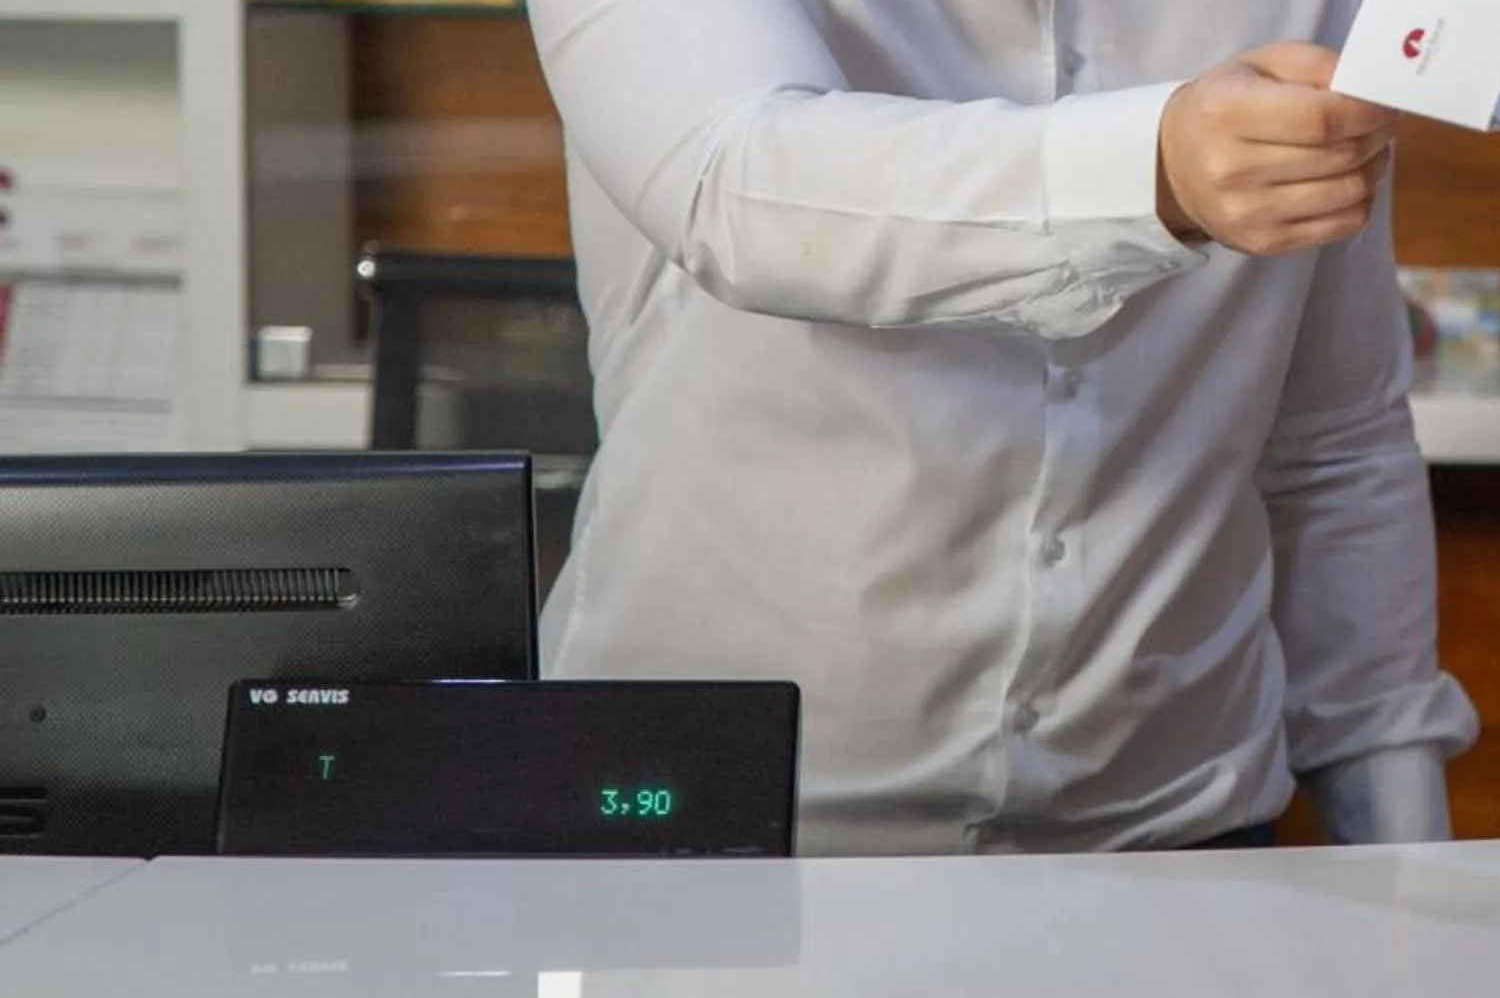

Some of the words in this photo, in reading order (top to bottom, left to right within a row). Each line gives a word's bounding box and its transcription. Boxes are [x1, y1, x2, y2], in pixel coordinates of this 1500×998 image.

[286, 688, 350, 704] SERVIS
[319, 755, 336, 780] T
[600, 789, 671, 815] 3,90
